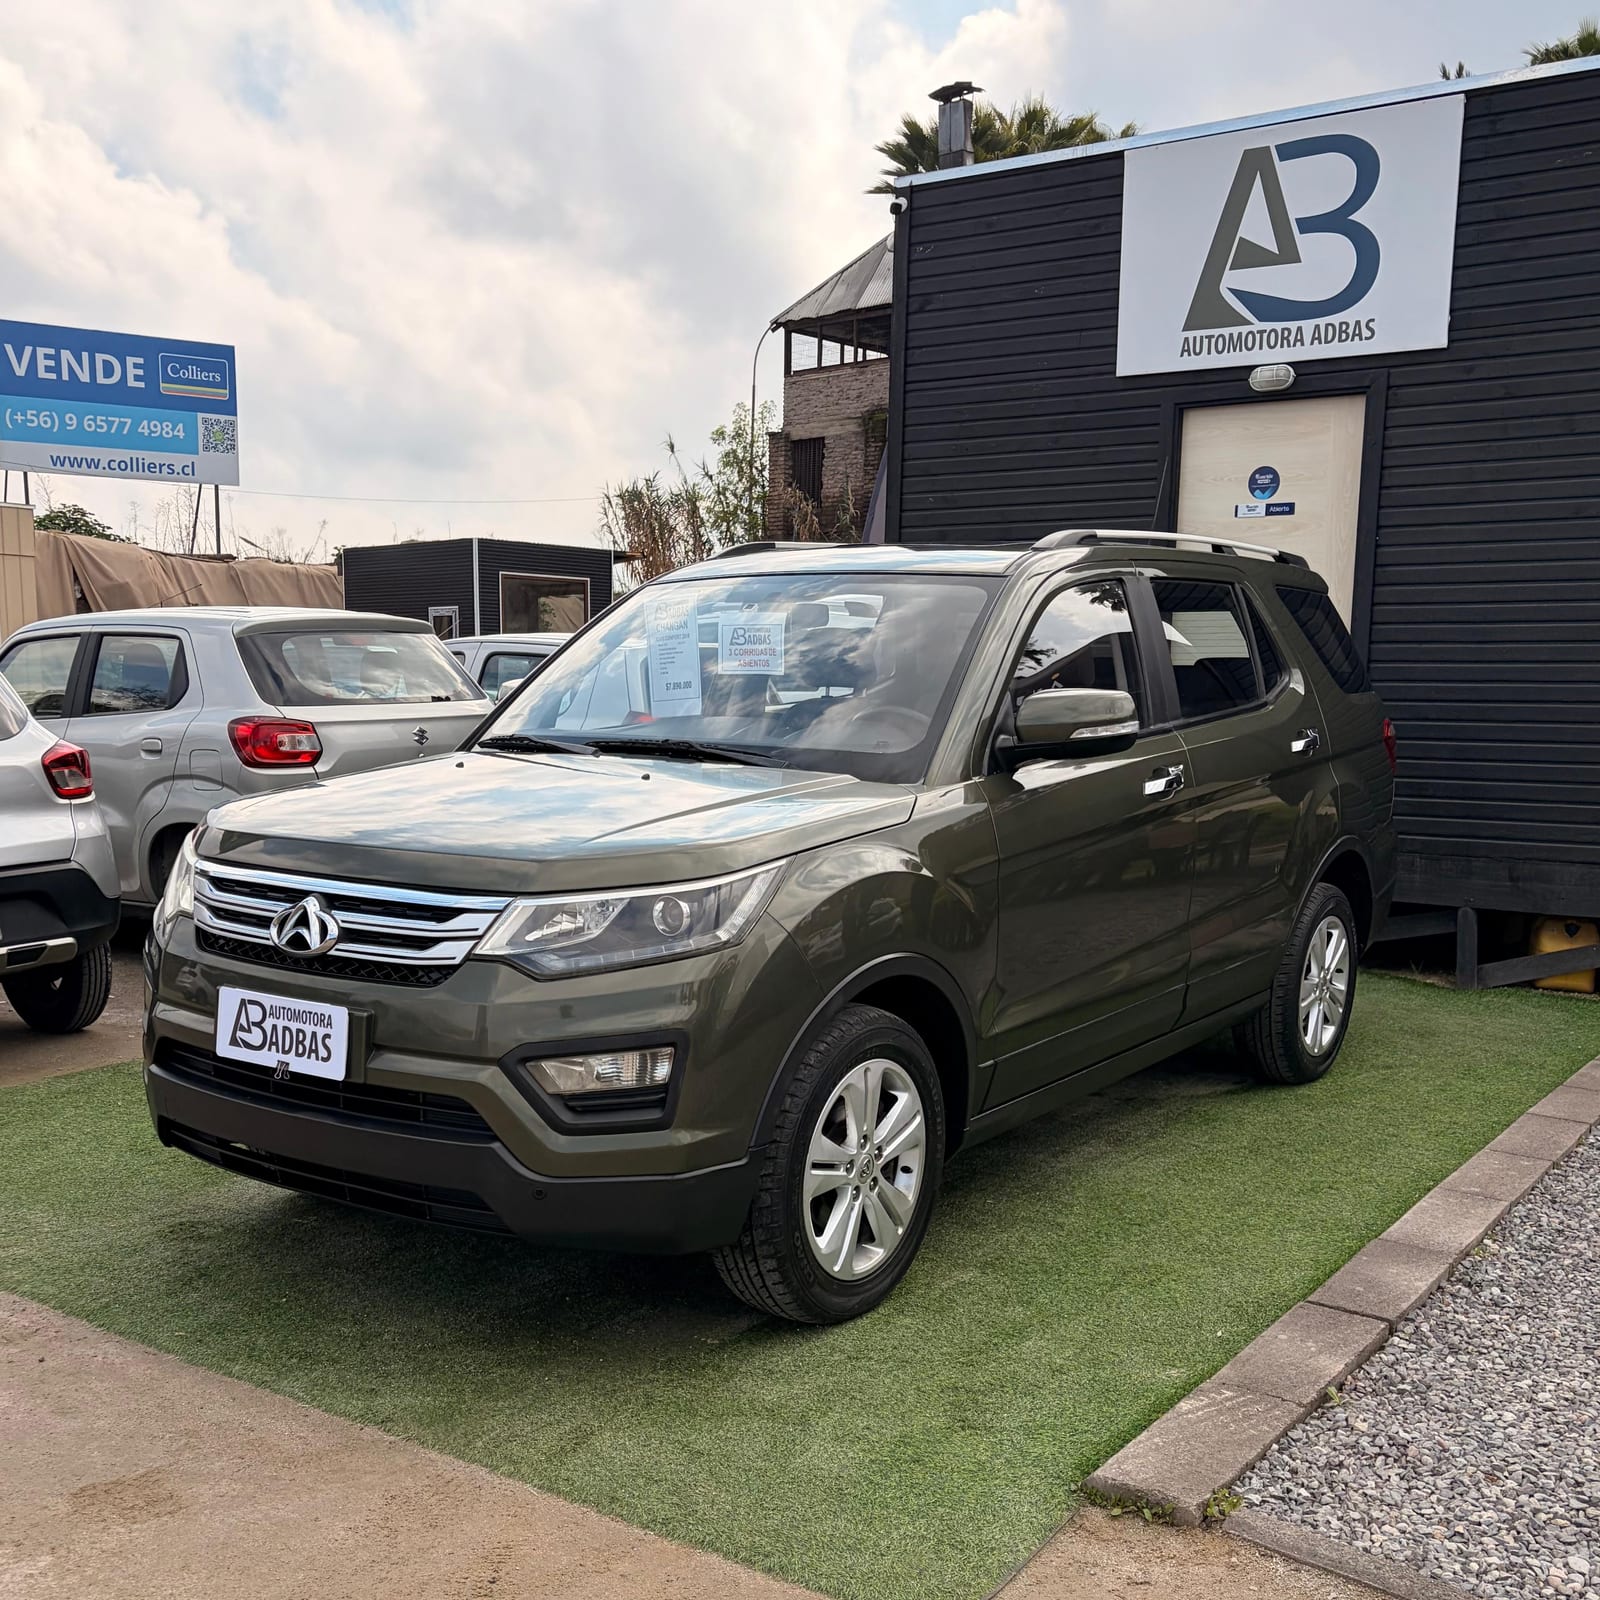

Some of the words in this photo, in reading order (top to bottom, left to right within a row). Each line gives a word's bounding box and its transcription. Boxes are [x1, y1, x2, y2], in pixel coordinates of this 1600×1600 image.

[1180, 326, 1305, 357] AUTOMOTORA
[1310, 318, 1376, 346] ADBAS
[4, 343, 145, 388] VENDE
[167, 363, 221, 382] Colliers
[5, 408, 59, 432] (+56)
[64, 413, 77, 430] 9
[83, 415, 132, 435] 6577
[138, 419, 185, 439] 4984
[50, 454, 196, 477] www.colliers.cl
[656, 619, 688, 632] CHANGAN
[747, 634, 772, 646] ADBAS
[734, 648, 768, 657] CORRIDAS
[768, 648, 777, 657] DE
[738, 659, 770, 668] ASIENTOS
[268, 1005, 333, 1029] AUTOMOTORA
[267, 1024, 332, 1063] ADBAS
